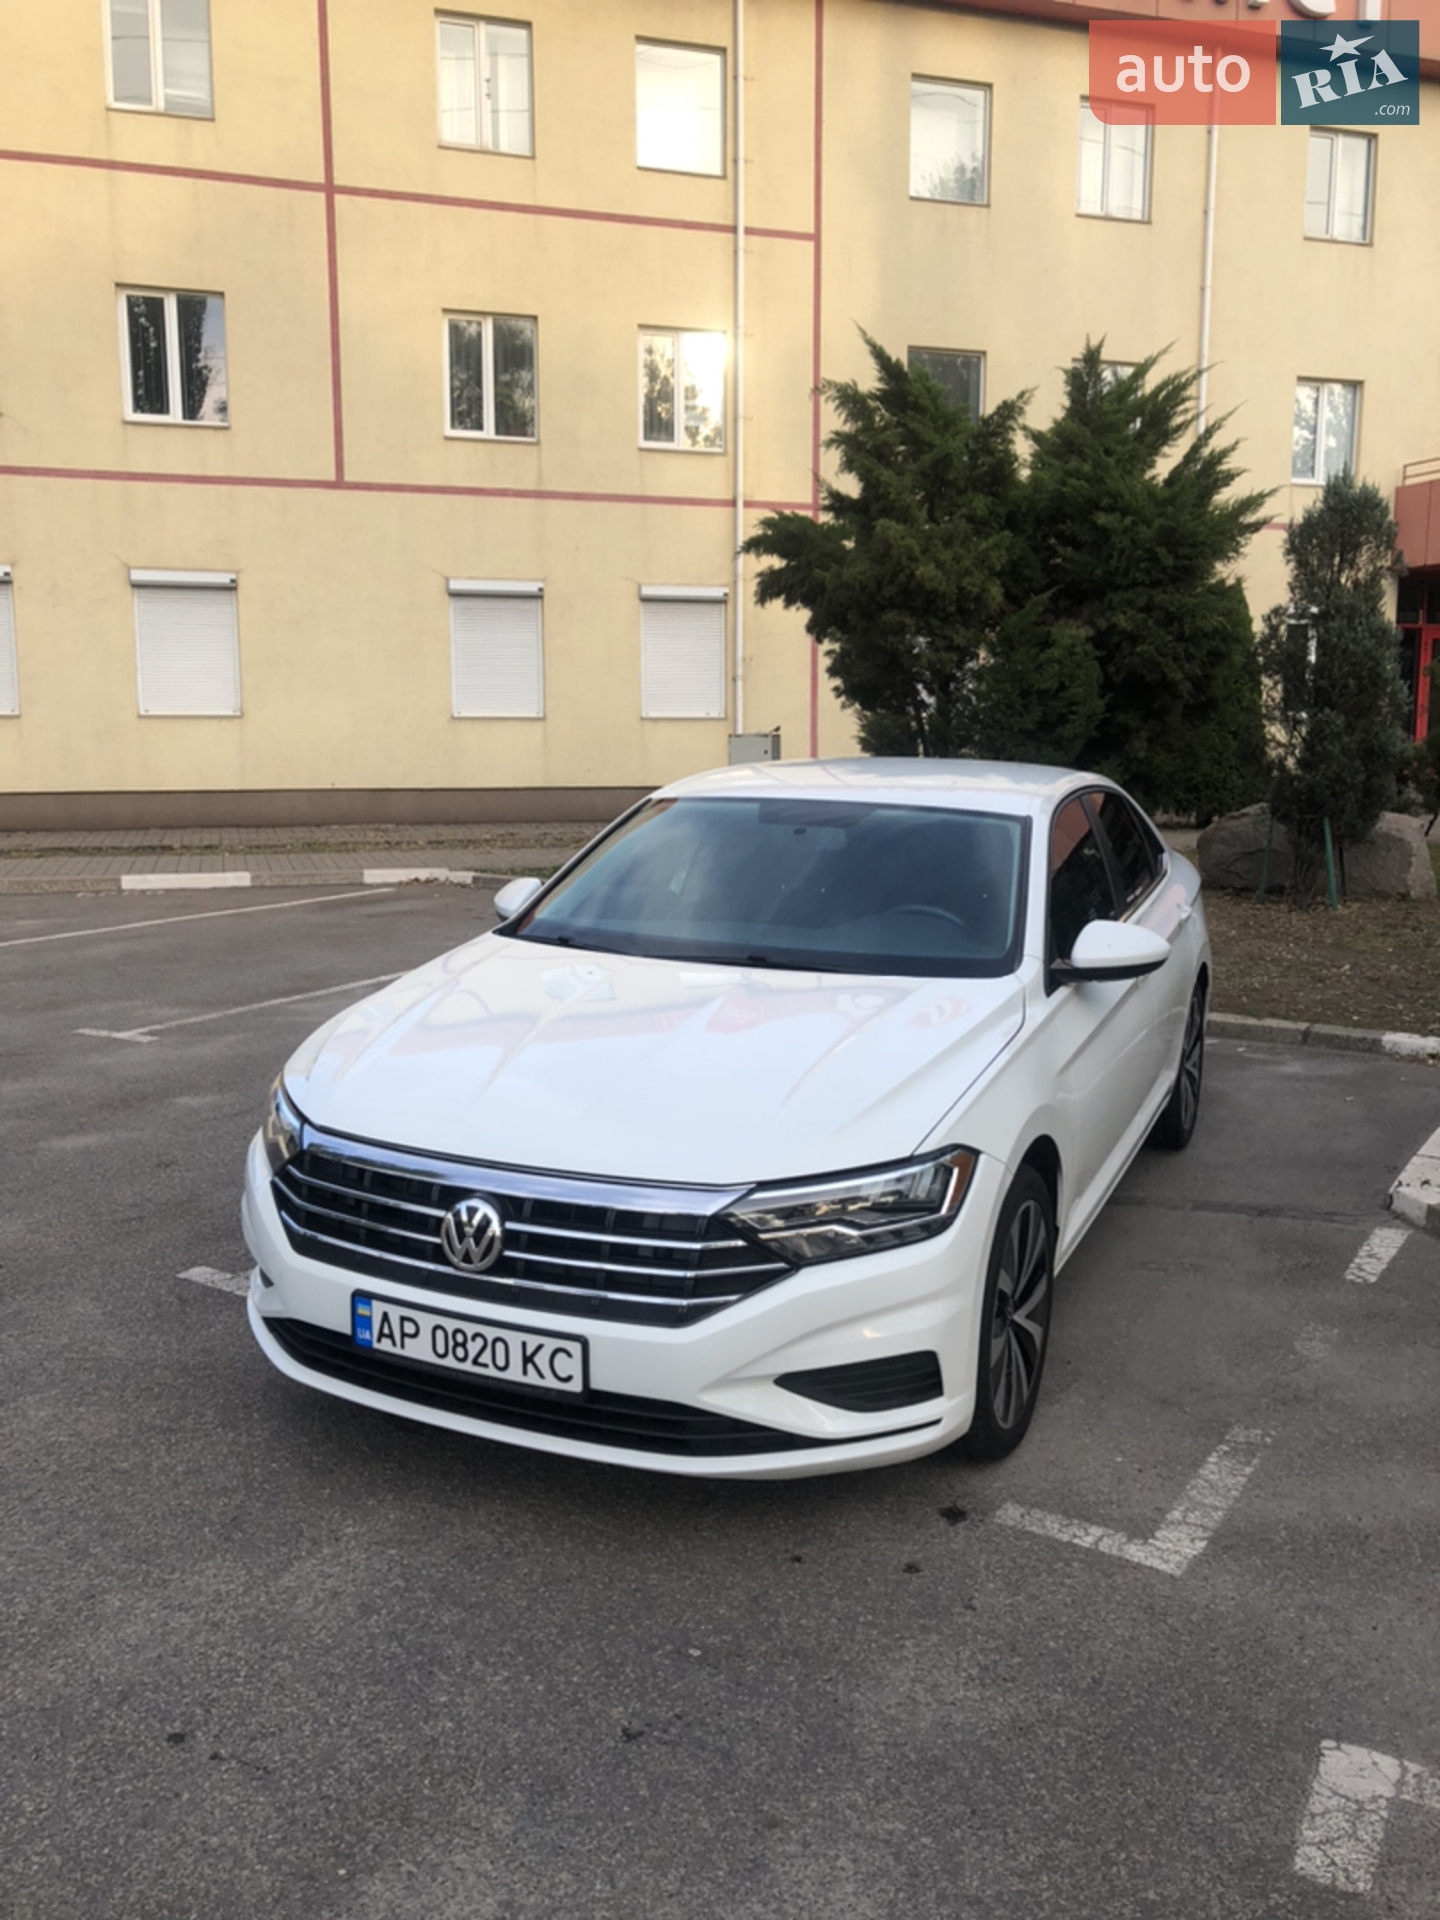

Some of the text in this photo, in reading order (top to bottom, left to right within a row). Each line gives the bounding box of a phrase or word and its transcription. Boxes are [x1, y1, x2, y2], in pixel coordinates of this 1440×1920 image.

[357, 1327, 371, 1340] UA
[376, 1310, 574, 1383] AP 0820 KC
